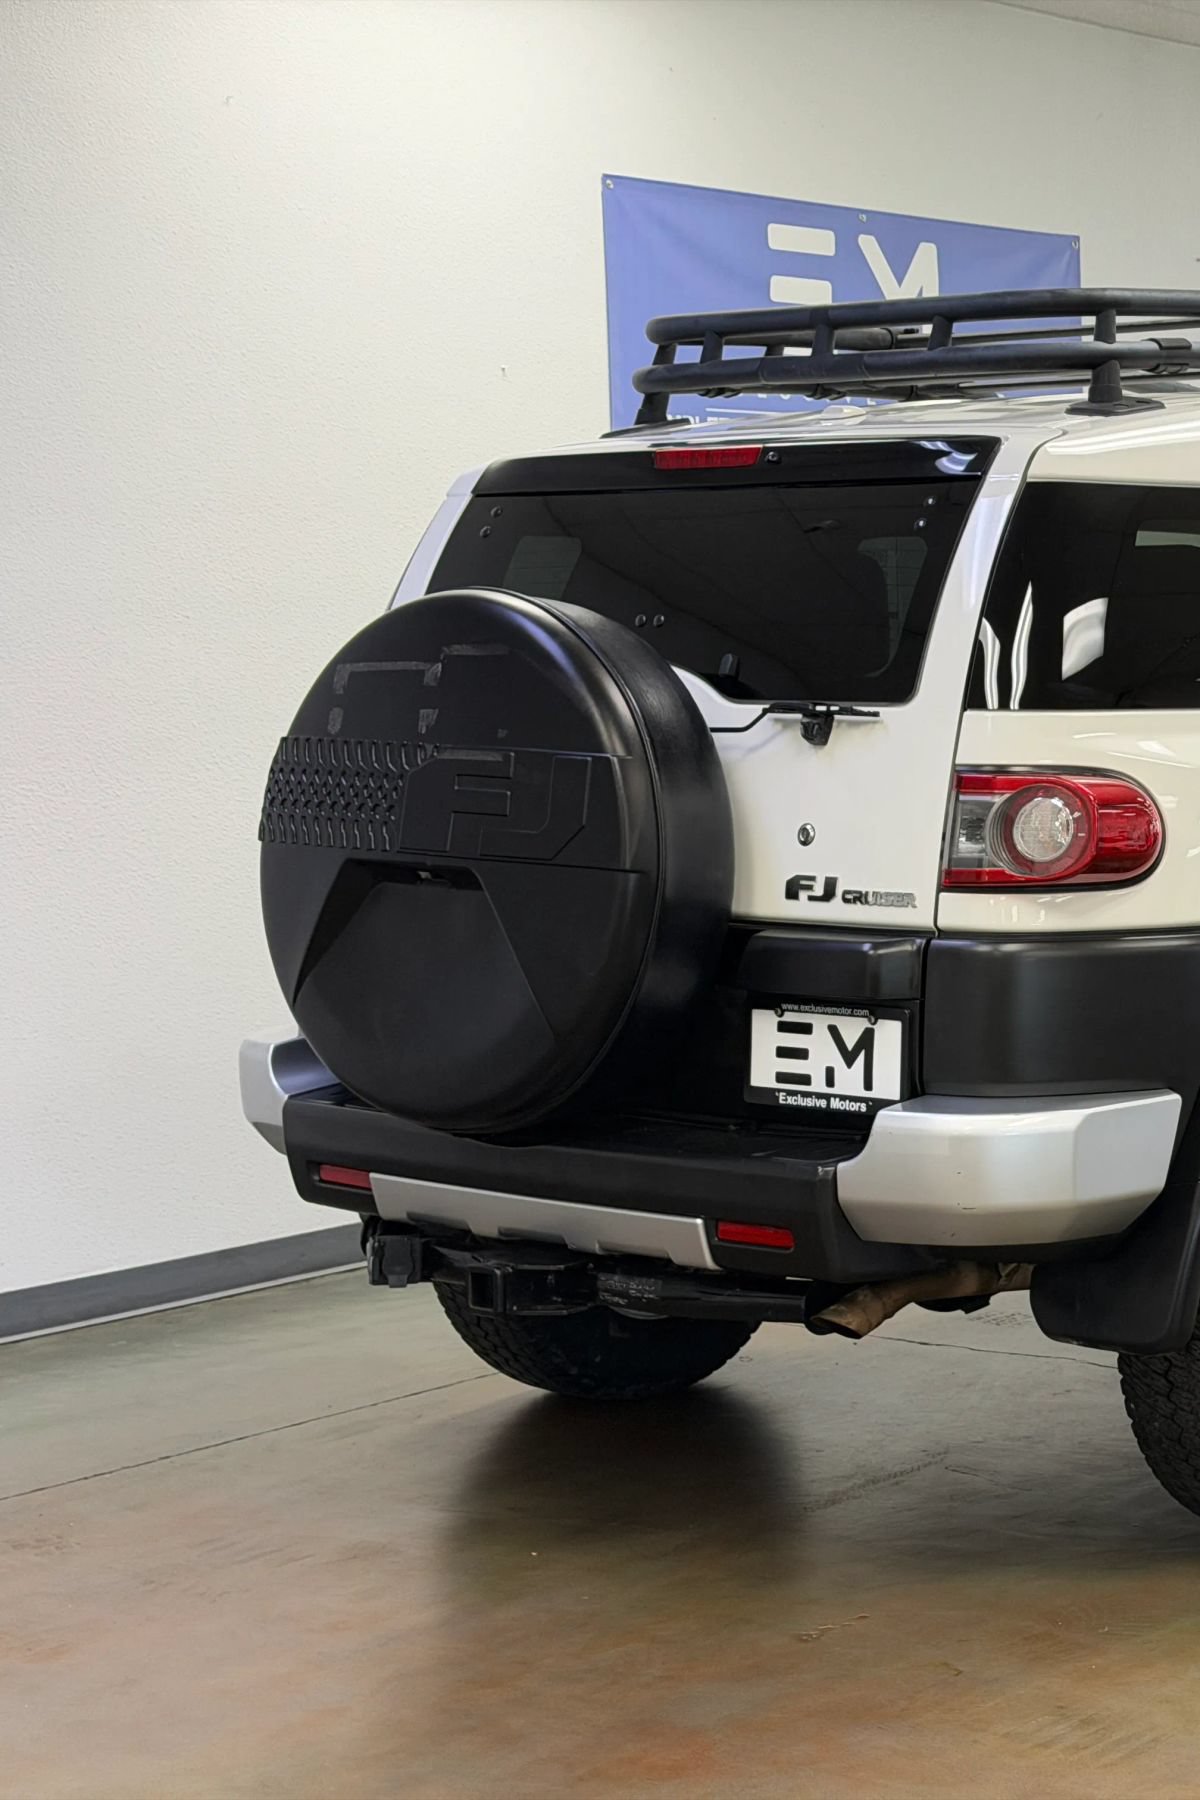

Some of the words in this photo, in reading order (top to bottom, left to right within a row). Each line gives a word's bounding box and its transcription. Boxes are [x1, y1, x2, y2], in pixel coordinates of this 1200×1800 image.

[785, 874, 838, 902] FJ
[842, 889, 918, 908] CRUISER
[781, 1002, 870, 1017] www.exclusivemotor.com
[775, 1020, 875, 1091] EM
